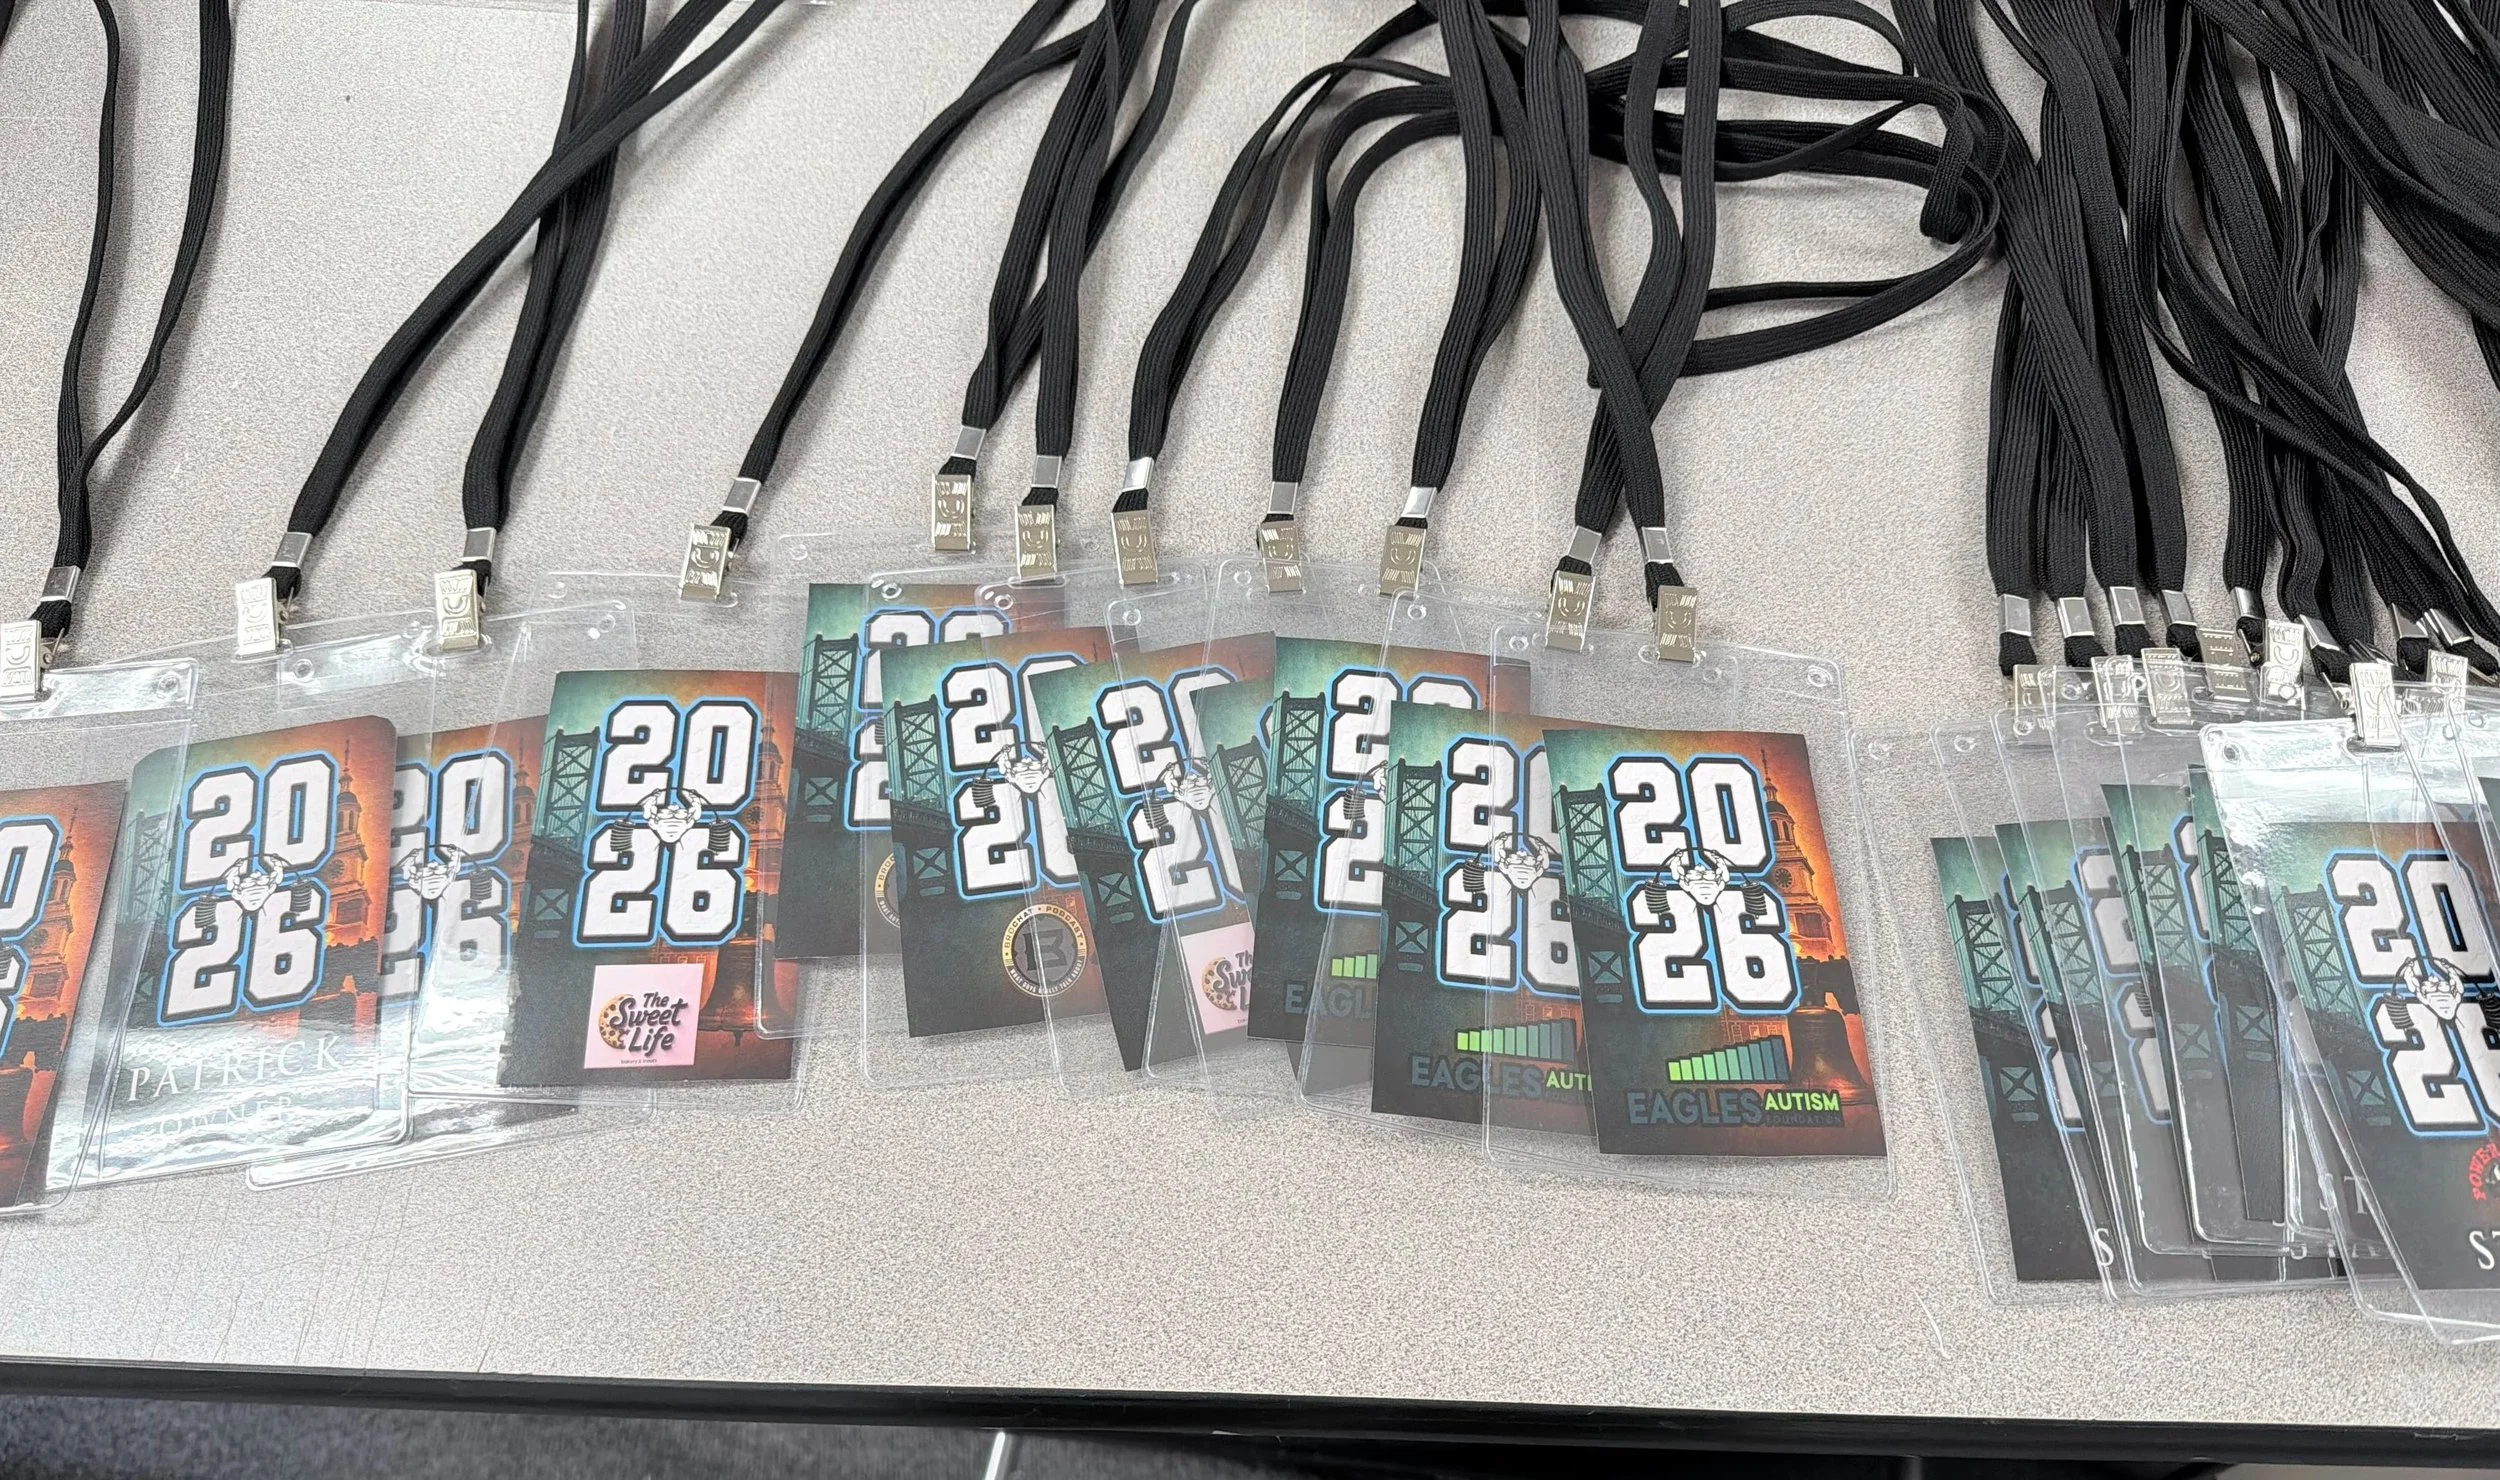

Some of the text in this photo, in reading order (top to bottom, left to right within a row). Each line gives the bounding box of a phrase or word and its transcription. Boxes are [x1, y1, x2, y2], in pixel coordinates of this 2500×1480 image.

[597, 699, 759, 812] 20
[181, 752, 338, 894] 20
[1607, 755, 1774, 873] 20
[574, 820, 747, 946] 26
[1004, 905, 1084, 948] BROCHAT PODCAST
[1626, 880, 1799, 1013] 26
[2325, 851, 2498, 986] 20
[159, 879, 327, 1026] 26
[1235, 950, 1253, 968] Th
[609, 997, 689, 1029] Sweet
[643, 991, 670, 1008] The
[128, 1035, 343, 1102] PATRICK
[628, 1026, 675, 1057] Life
[1411, 1055, 1543, 1098] EAGLES
[1626, 1091, 1840, 1125] EAGLES AUTISM
